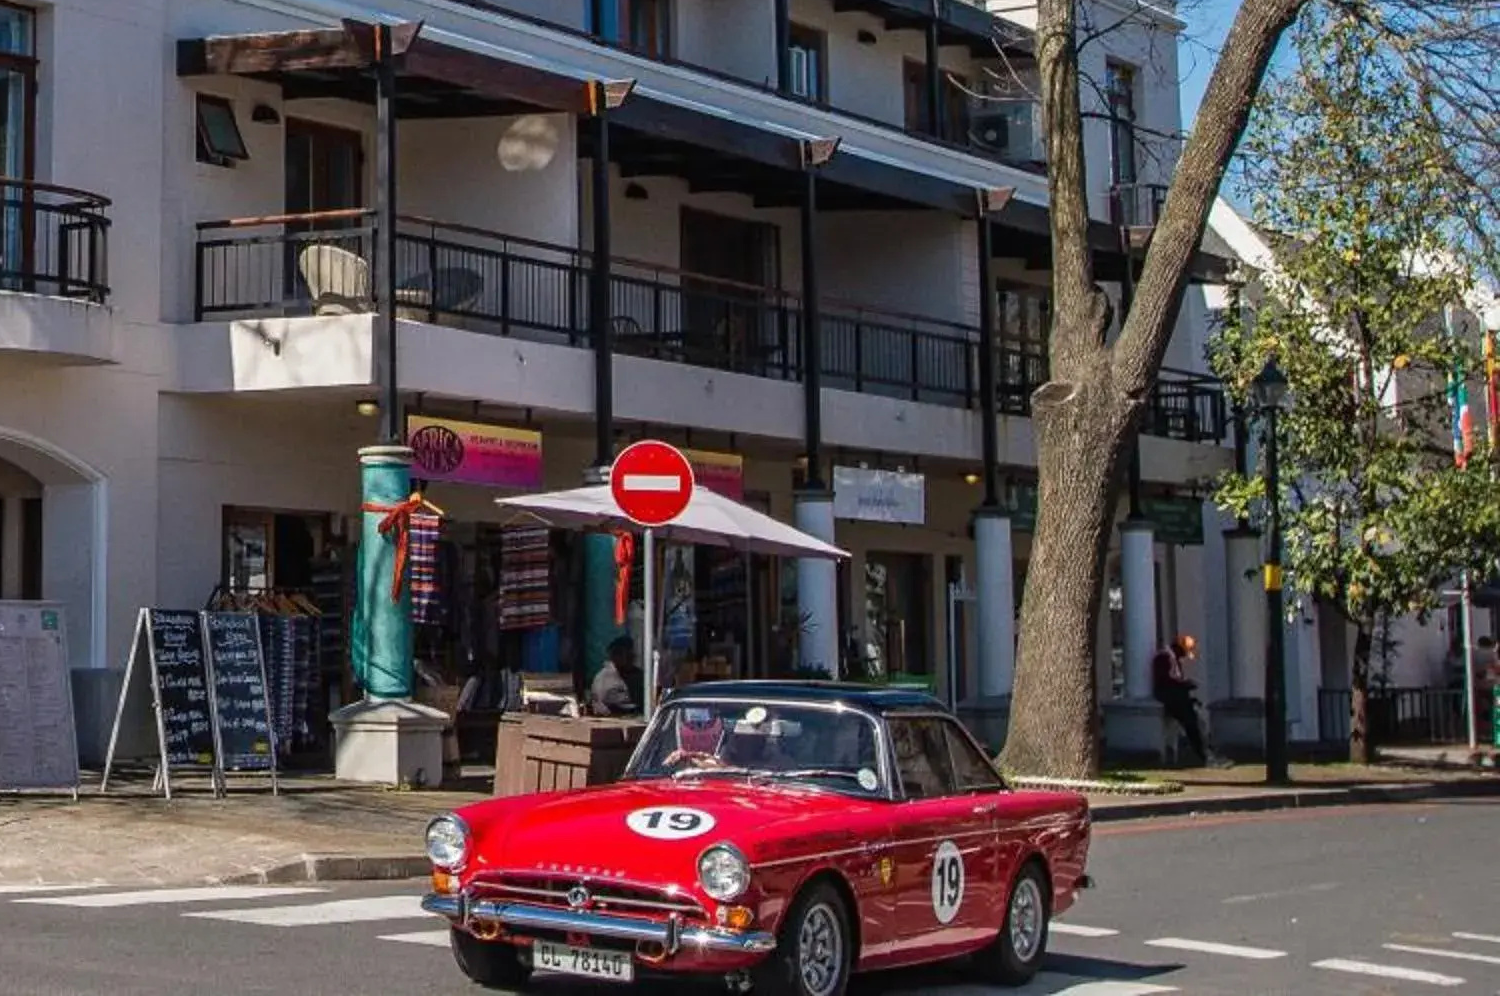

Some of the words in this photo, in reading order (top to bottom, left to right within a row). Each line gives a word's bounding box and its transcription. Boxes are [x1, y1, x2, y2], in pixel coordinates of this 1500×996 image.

[641, 811, 701, 831] 19
[937, 857, 960, 907] 19
[542, 945, 561, 966] CL
